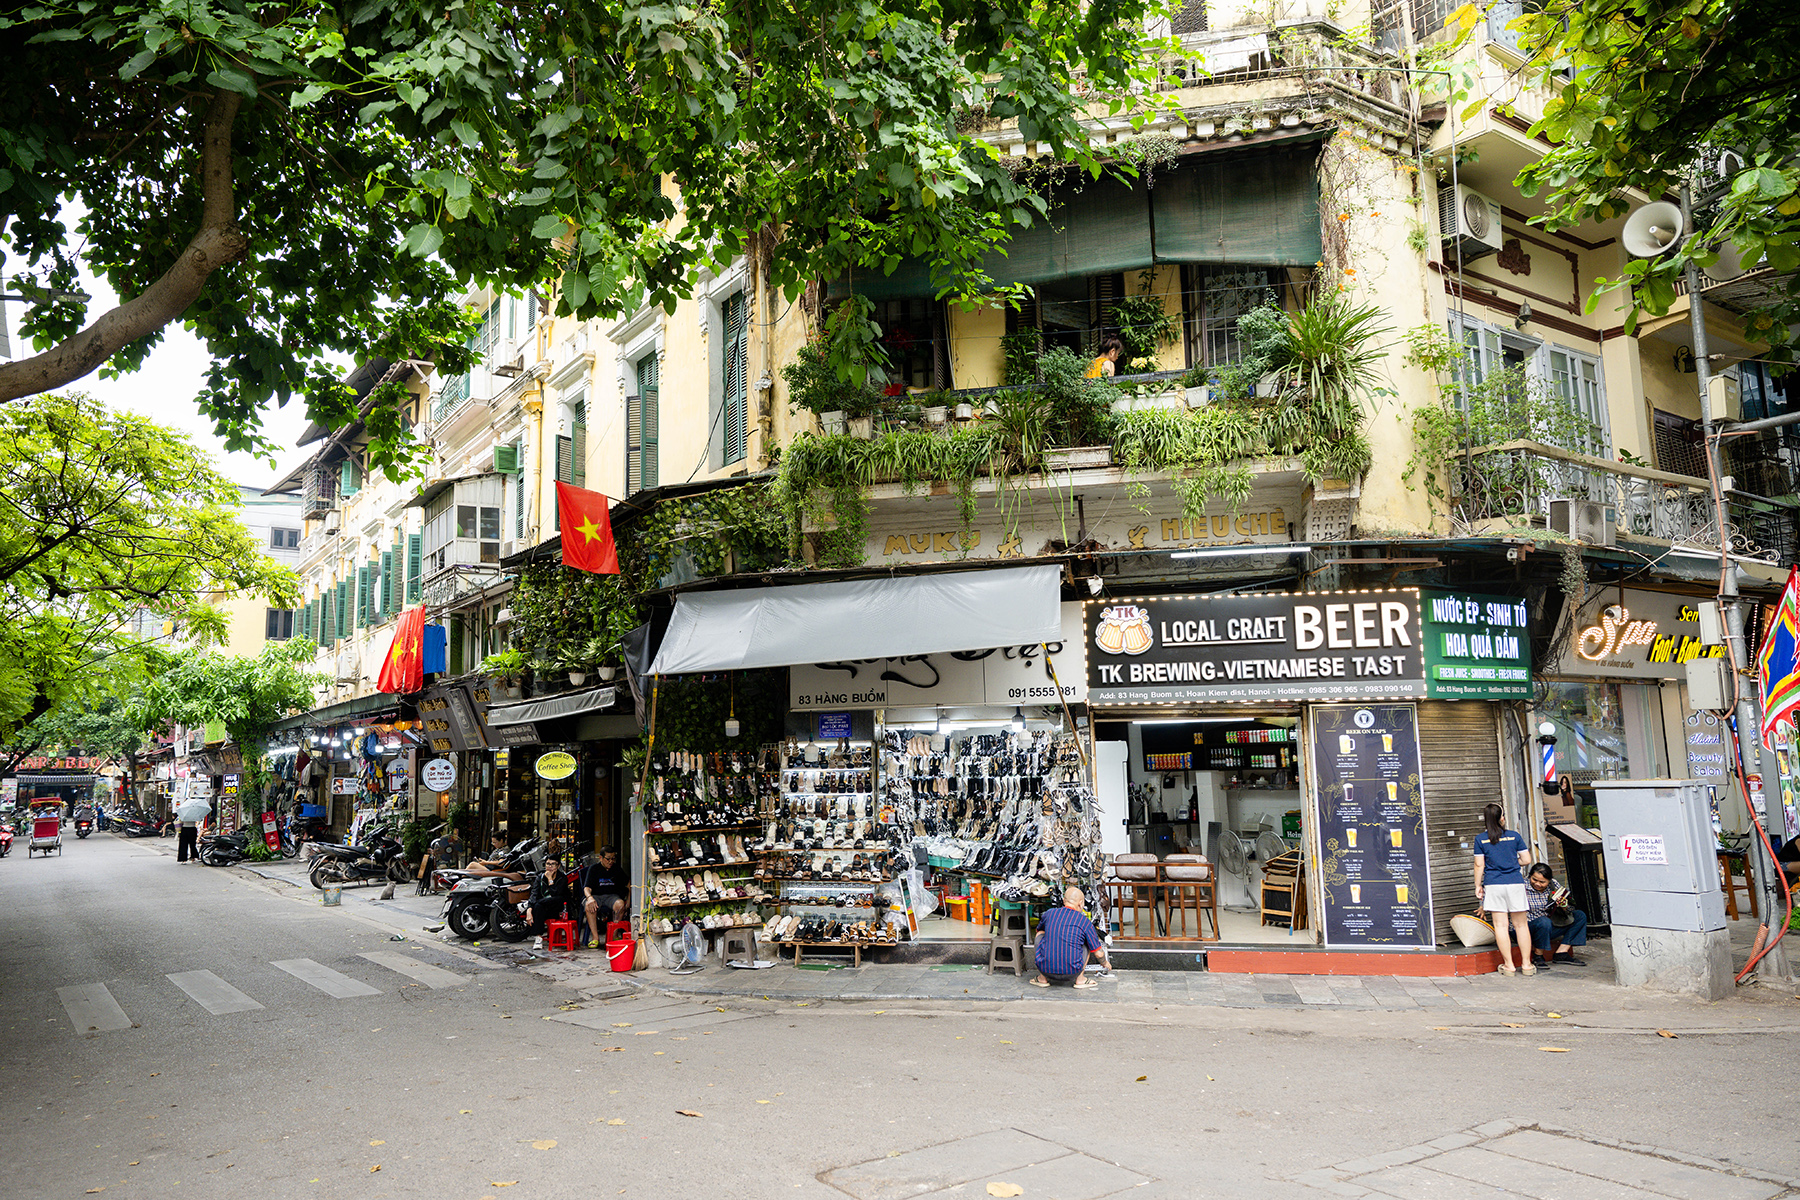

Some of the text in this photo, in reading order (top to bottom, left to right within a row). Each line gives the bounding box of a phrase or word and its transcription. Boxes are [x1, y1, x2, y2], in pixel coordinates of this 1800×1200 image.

[1115, 606, 1134, 618] TK
[1432, 595, 1463, 624] NƯỚC
[1465, 597, 1480, 624] ÉP
[1486, 602, 1512, 626] SINH
[1513, 598, 1527, 628] TỐ
[1161, 601, 1412, 651] LOCAL CRAFT BEER
[1578, 605, 1657, 660] Spa
[1445, 633, 1469, 657] HOA
[1471, 627, 1493, 660] QUẢ
[1650, 633, 1675, 663] Foot
[1098, 655, 1406, 684] TK BREWING-VIETNAMESE TAST
[798, 688, 886, 704] 83 HÀNG BUỒM
[1008, 688, 1027, 698] 091
[1029, 687, 1055, 697] 5555
[1129, 691, 1149, 700] Hang
[1174, 691, 1185, 699] st,
[1208, 688, 1228, 697] Kiem
[1230, 688, 1247, 697] dist,
[1248, 687, 1270, 695] Hanoi
[1277, 687, 1306, 695] Hotline:
[1308, 686, 1327, 694] 0985
[1364, 685, 1384, 693] 0983
[1384, 685, 1399, 693] 090
[1400, 684, 1413, 692] 140
[1689, 751, 1723, 764] Beauty
[396, 767, 405, 779] 10
[1693, 765, 1723, 776] Salon
